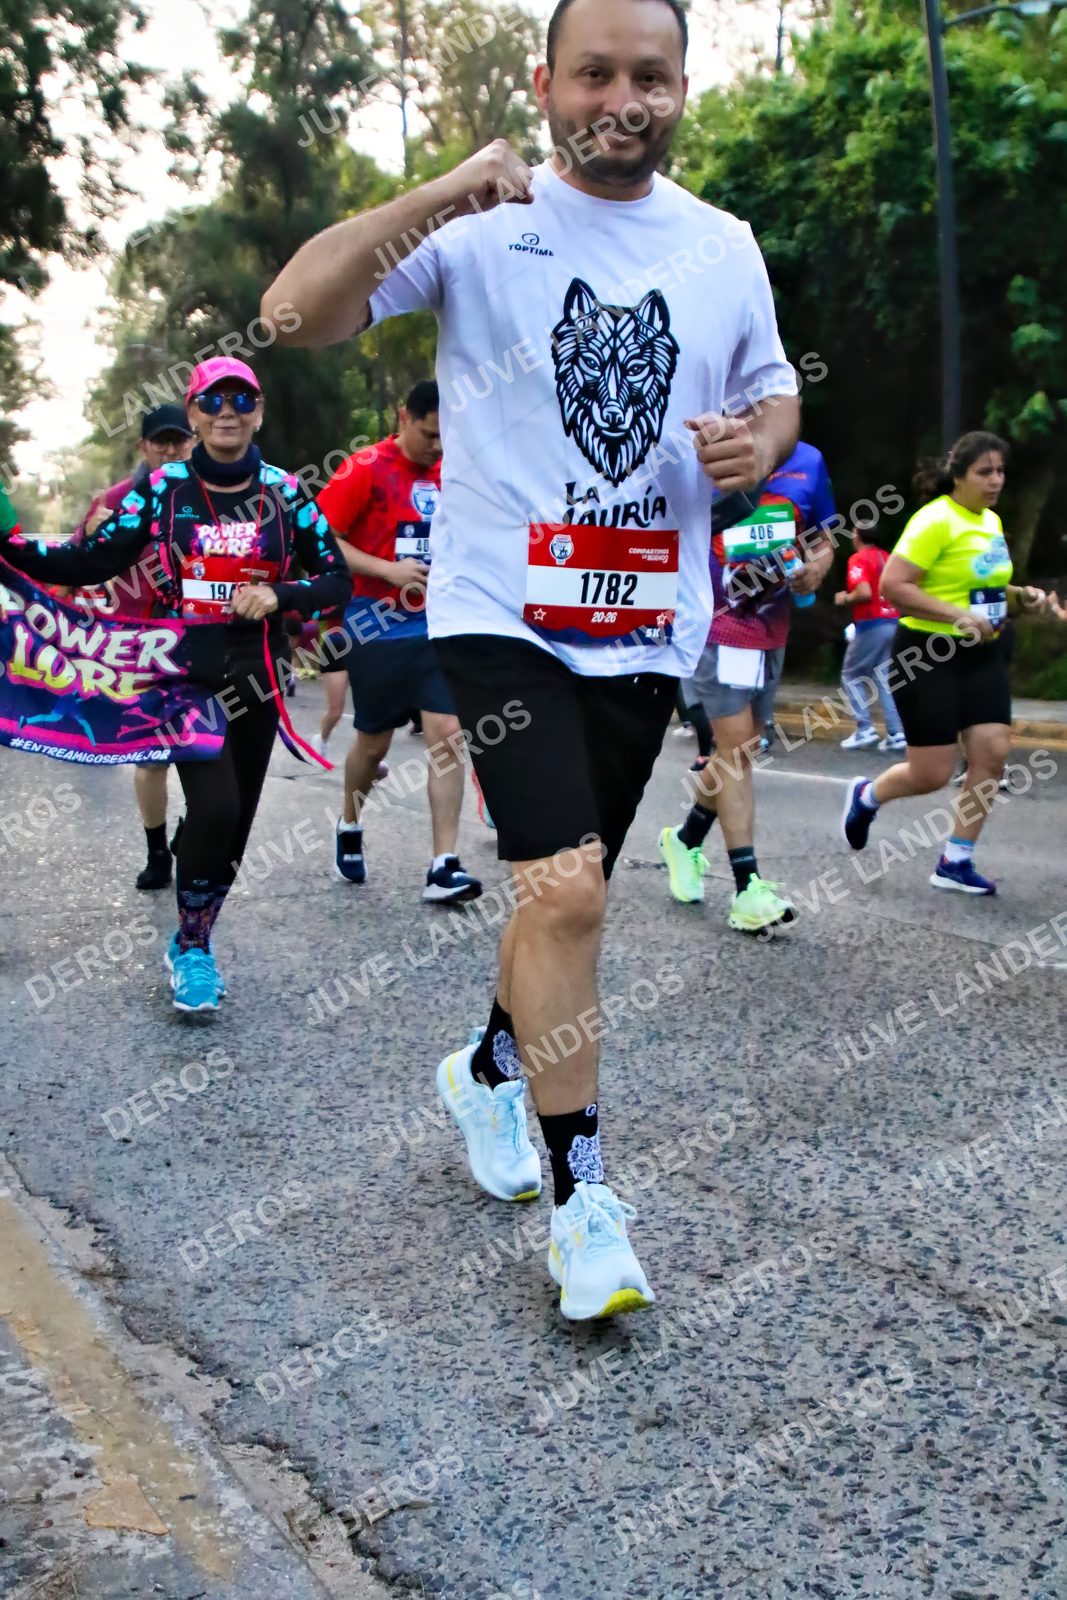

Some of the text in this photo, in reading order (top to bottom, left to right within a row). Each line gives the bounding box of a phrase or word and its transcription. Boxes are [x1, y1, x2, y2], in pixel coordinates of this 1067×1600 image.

[565, 481, 600, 505] LA
[198, 521, 258, 540] POWER
[750, 524, 774, 540] 406
[204, 538, 251, 556] LORE
[580, 572, 638, 605] 1782
[10, 737, 171, 764] #ENTREAMIGOSESMEJOR
